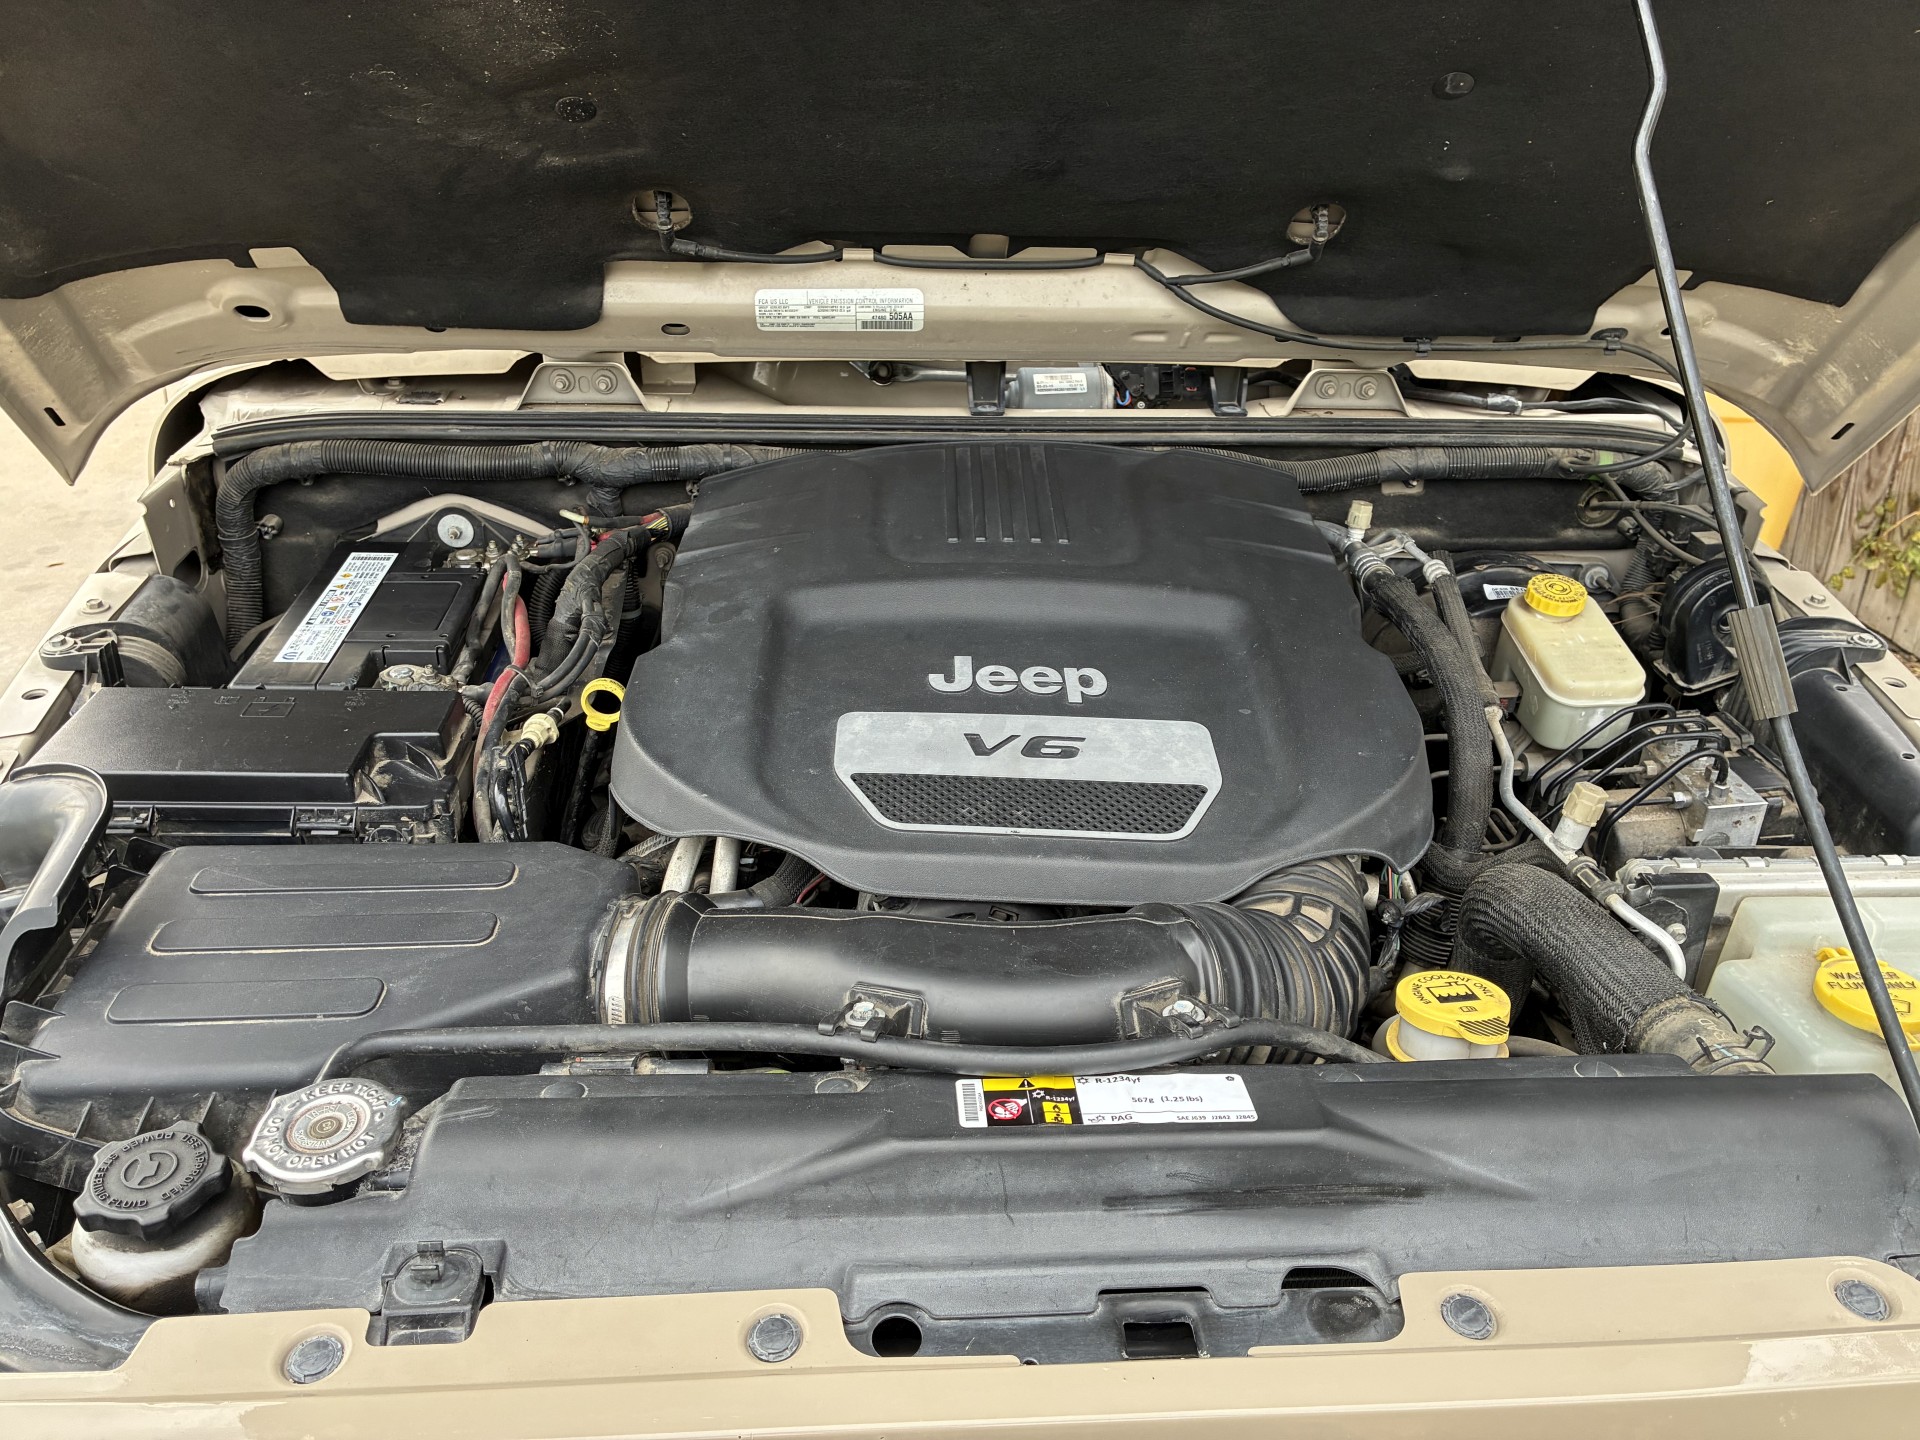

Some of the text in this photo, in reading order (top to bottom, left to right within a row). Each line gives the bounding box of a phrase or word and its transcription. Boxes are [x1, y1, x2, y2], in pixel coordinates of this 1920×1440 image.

[889, 312, 913, 321] 505AA
[928, 655, 1108, 704] Jeep
[964, 733, 1087, 760] V6
[1827, 981, 1865, 990] FLUI
[1829, 971, 1900, 980] WASER
[1411, 974, 1496, 1005] ENGINE COOLANT ONLY
[1095, 1076, 1142, 1085] R-1234yf
[301, 1082, 389, 1110] KEEP TIGHT
[1131, 1095, 1203, 1104] 567g (1.25 lbs)
[1110, 1113, 1133, 1122] PAG
[264, 1116, 376, 1169] DO NOT OPEN HOT
[93, 1131, 176, 1209] POWER STEERING FLUID
[161, 1133, 206, 1200] USE APPROVED
